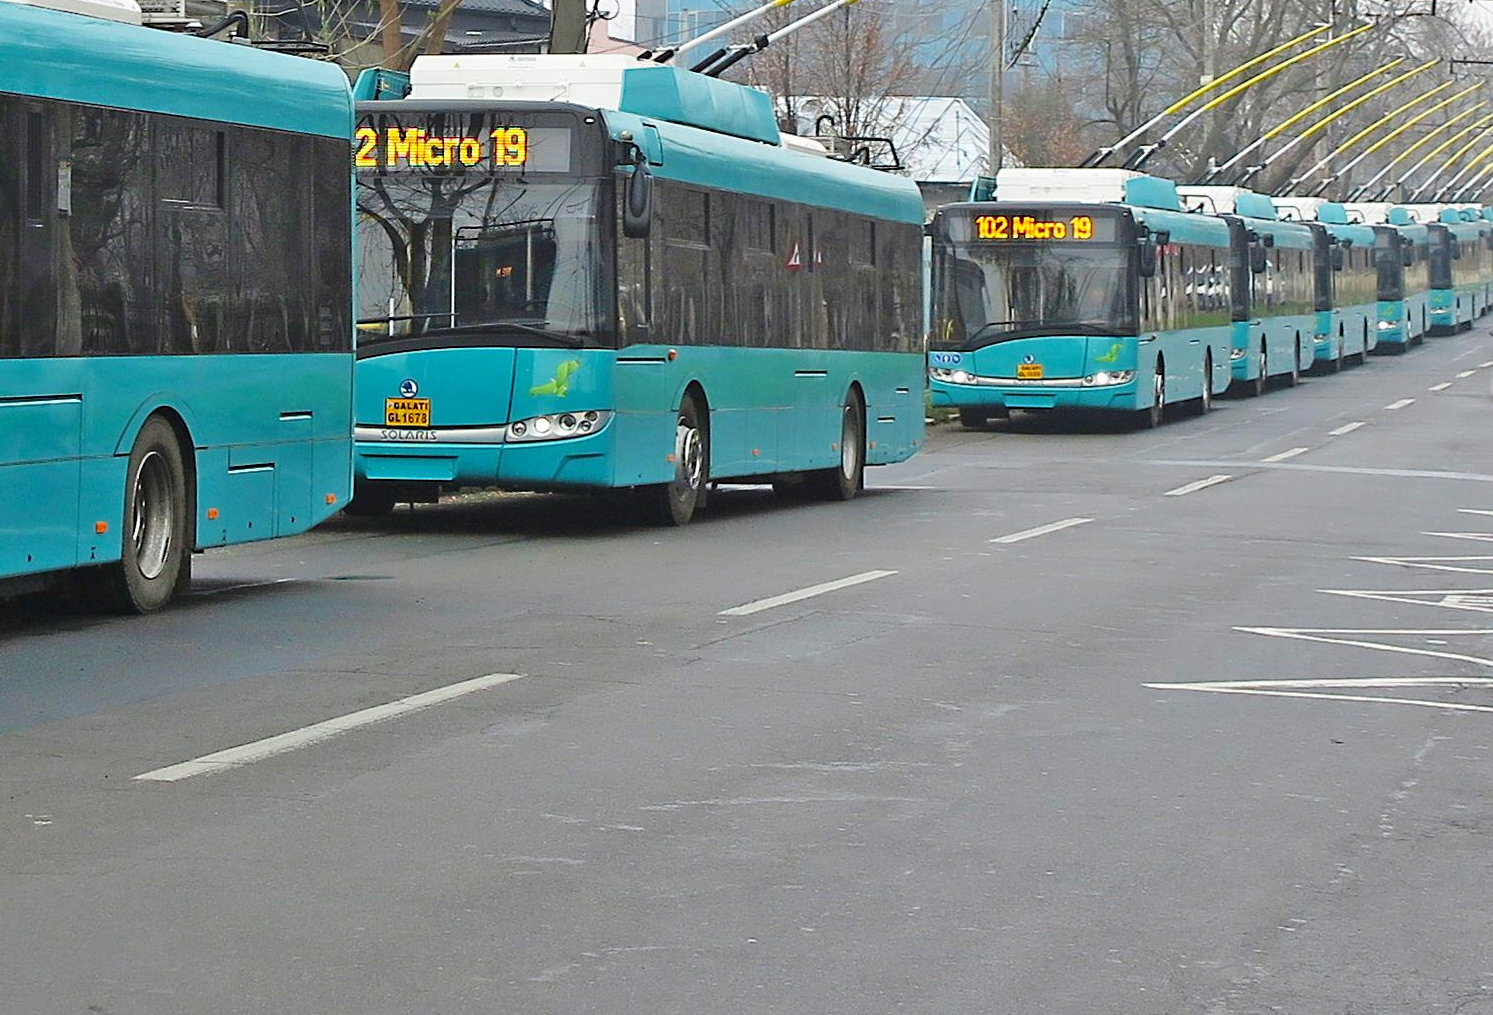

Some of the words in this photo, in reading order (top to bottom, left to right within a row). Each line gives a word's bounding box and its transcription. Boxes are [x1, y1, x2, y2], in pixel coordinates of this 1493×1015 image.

[386, 126, 481, 168] Micro
[490, 126, 528, 168] 19
[975, 214, 1009, 240] 102
[1011, 214, 1067, 240] Micro
[1069, 215, 1093, 240] 19
[394, 402, 428, 410] GALATI
[380, 429, 437, 440] SOLARIS
